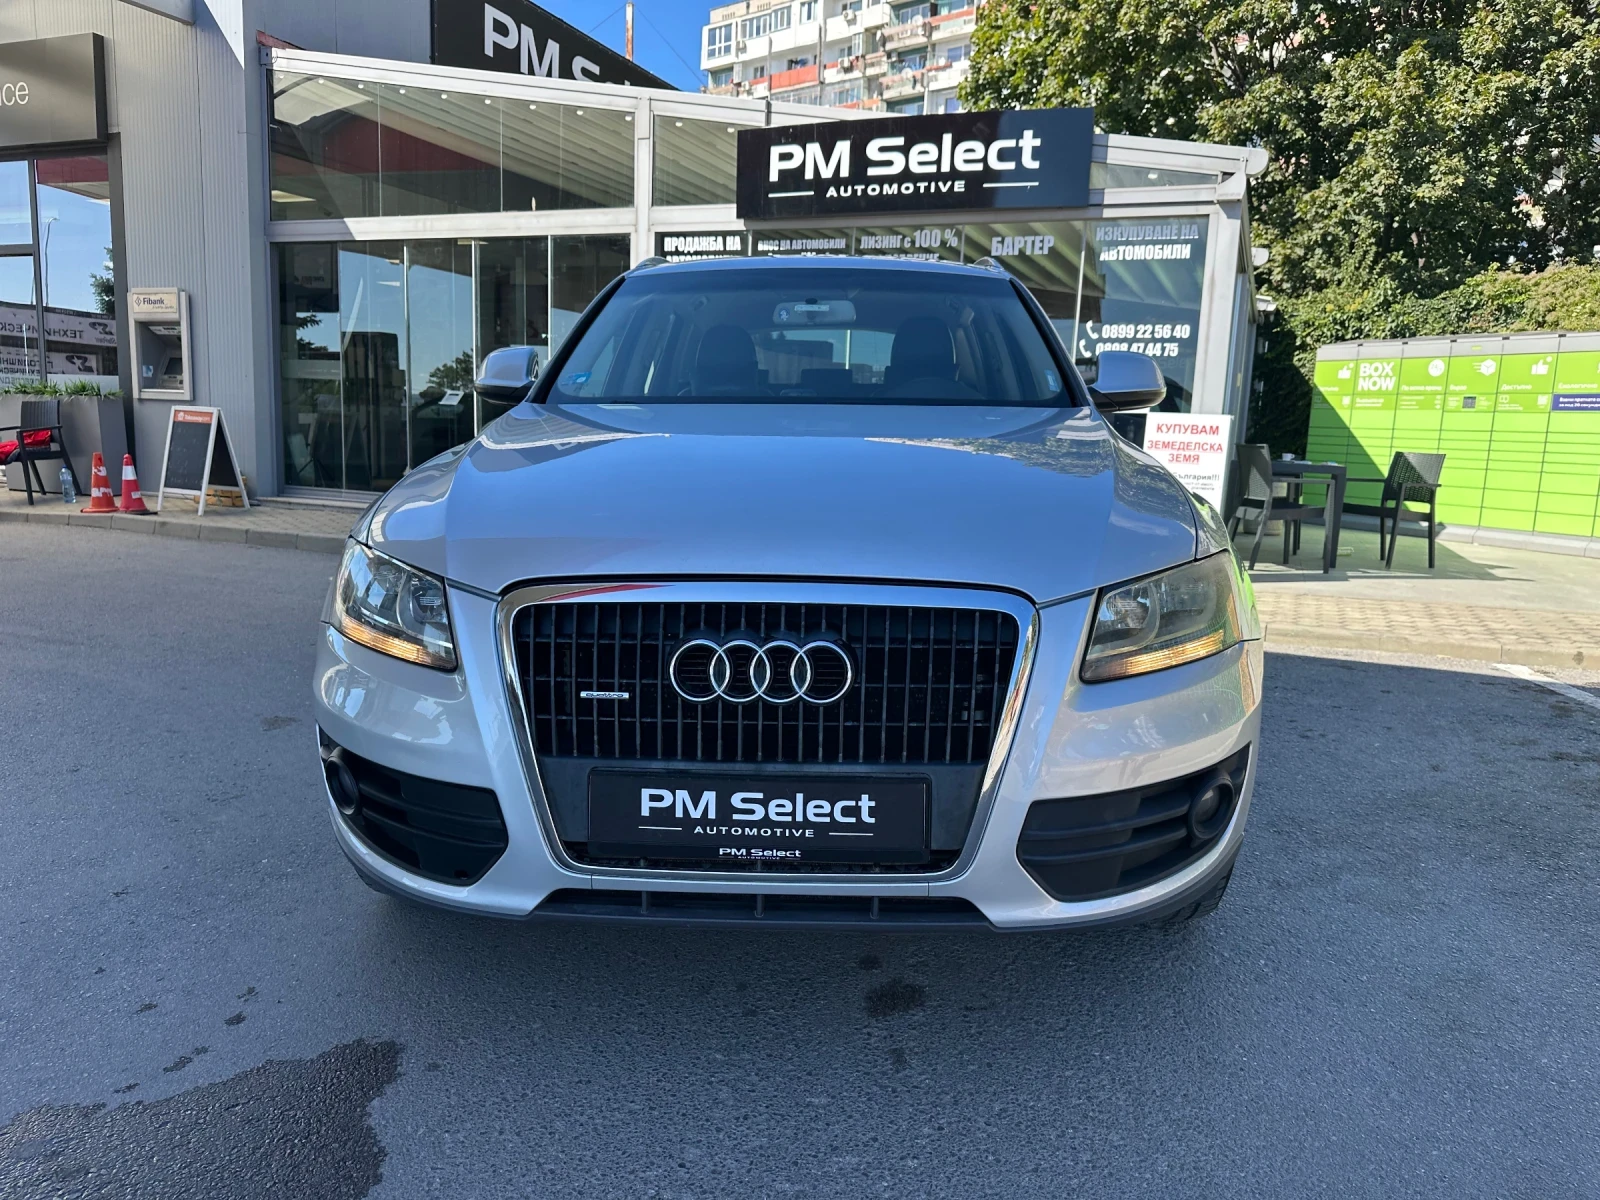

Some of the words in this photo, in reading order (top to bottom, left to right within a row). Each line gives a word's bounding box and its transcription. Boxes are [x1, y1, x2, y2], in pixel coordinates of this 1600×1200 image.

[484, 3, 560, 79] PM
[0, 81, 29, 106] ce
[769, 140, 850, 182] PM
[865, 129, 1042, 177] Select
[825, 180, 966, 198] AUTOMOTIVE
[860, 235, 902, 249] ЛИЗИНГ
[913, 229, 941, 248] 100
[944, 228, 958, 247] %
[1096, 225, 1179, 241] ИЗКУПУВАНЕ
[1181, 224, 1199, 239] НА
[664, 236, 723, 253] ПРОДАЖБА
[726, 235, 741, 251] НА
[780, 239, 791, 250] НА
[792, 238, 846, 250] АВТОМОБИЛИ
[991, 236, 1055, 256] БАРТЕР
[1100, 244, 1191, 261] АВТОМОБИЛИ
[142, 297, 165, 305] Fibank
[1101, 325, 1134, 339] 0899
[1136, 325, 1153, 338] 22
[1154, 325, 1171, 338] 56
[1173, 325, 1191, 338] 40
[1163, 343, 1179, 356] 75
[1360, 362, 1394, 377] BOX
[1358, 377, 1396, 391] NOW
[1156, 423, 1219, 436] КУПУВАМ
[1147, 440, 1223, 452] ЗЕМЕДЕЛСКА
[1168, 453, 1200, 463] ЗЕМЯ
[641, 788, 716, 819] PM
[730, 792, 876, 824] Select
[693, 825, 815, 838] AUTOMOTIVE
[719, 848, 747, 856] PM
[750, 849, 802, 858] Select
